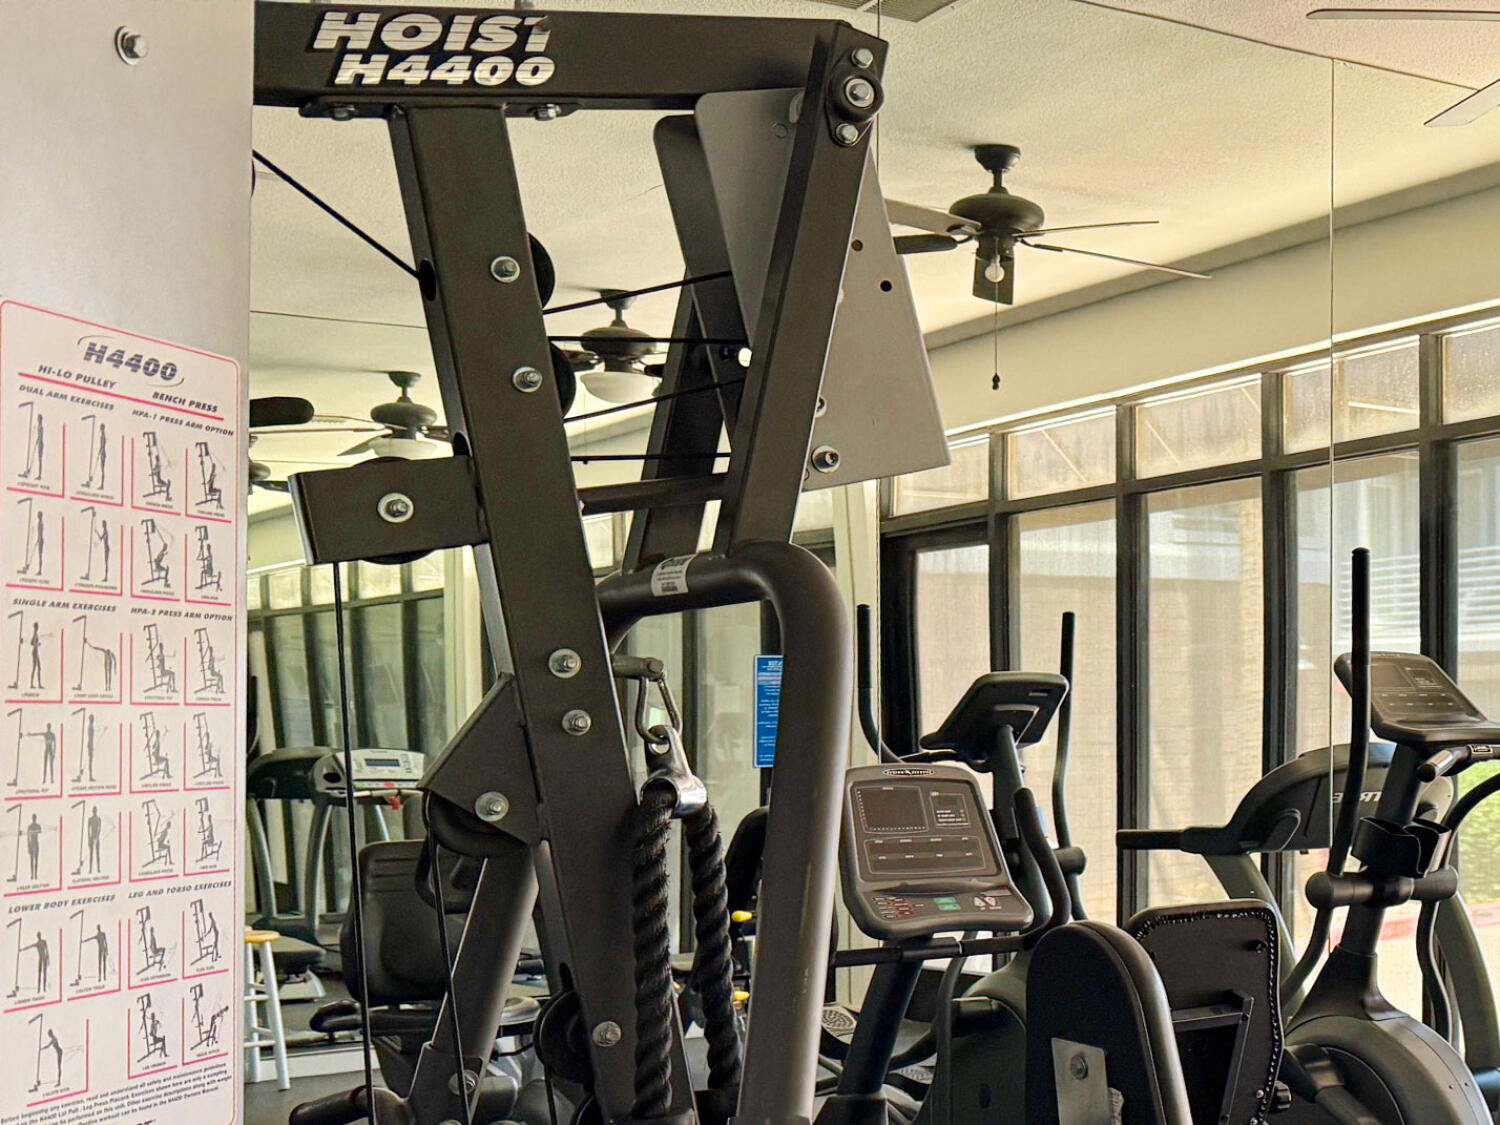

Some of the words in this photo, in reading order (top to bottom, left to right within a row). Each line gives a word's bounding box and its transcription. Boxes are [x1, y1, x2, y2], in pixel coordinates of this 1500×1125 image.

[313, 12, 551, 51] HOIST
[334, 54, 555, 86] H4400
[83, 341, 178, 381] H4400
[37, 364, 73, 380] HI-LO
[75, 372, 117, 390] PULLEY
[18, 384, 44, 397] DUAL
[46, 390, 68, 401] ARM
[70, 396, 115, 411] EXERCISES
[152, 391, 187, 406] BENCH
[189, 400, 219, 413] PRESS
[160, 415, 184, 426] PRESS
[185, 420, 204, 431] ARM
[205, 425, 235, 437] OPTION
[12, 598, 48, 608] SINGLE
[48, 601, 70, 610] ARM
[72, 602, 117, 613] EXERCISES
[158, 610, 182, 618] PRESS
[184, 612, 202, 620] ARM
[203, 614, 233, 622] OPTION
[128, 891, 145, 900] LEG
[146, 888, 165, 898] AND
[166, 884, 193, 895] TORSO
[194, 880, 233, 892] EXERCISES
[8, 903, 42, 915] LOWER
[44, 899, 69, 911] BODY
[71, 895, 117, 908] EXERCISES
